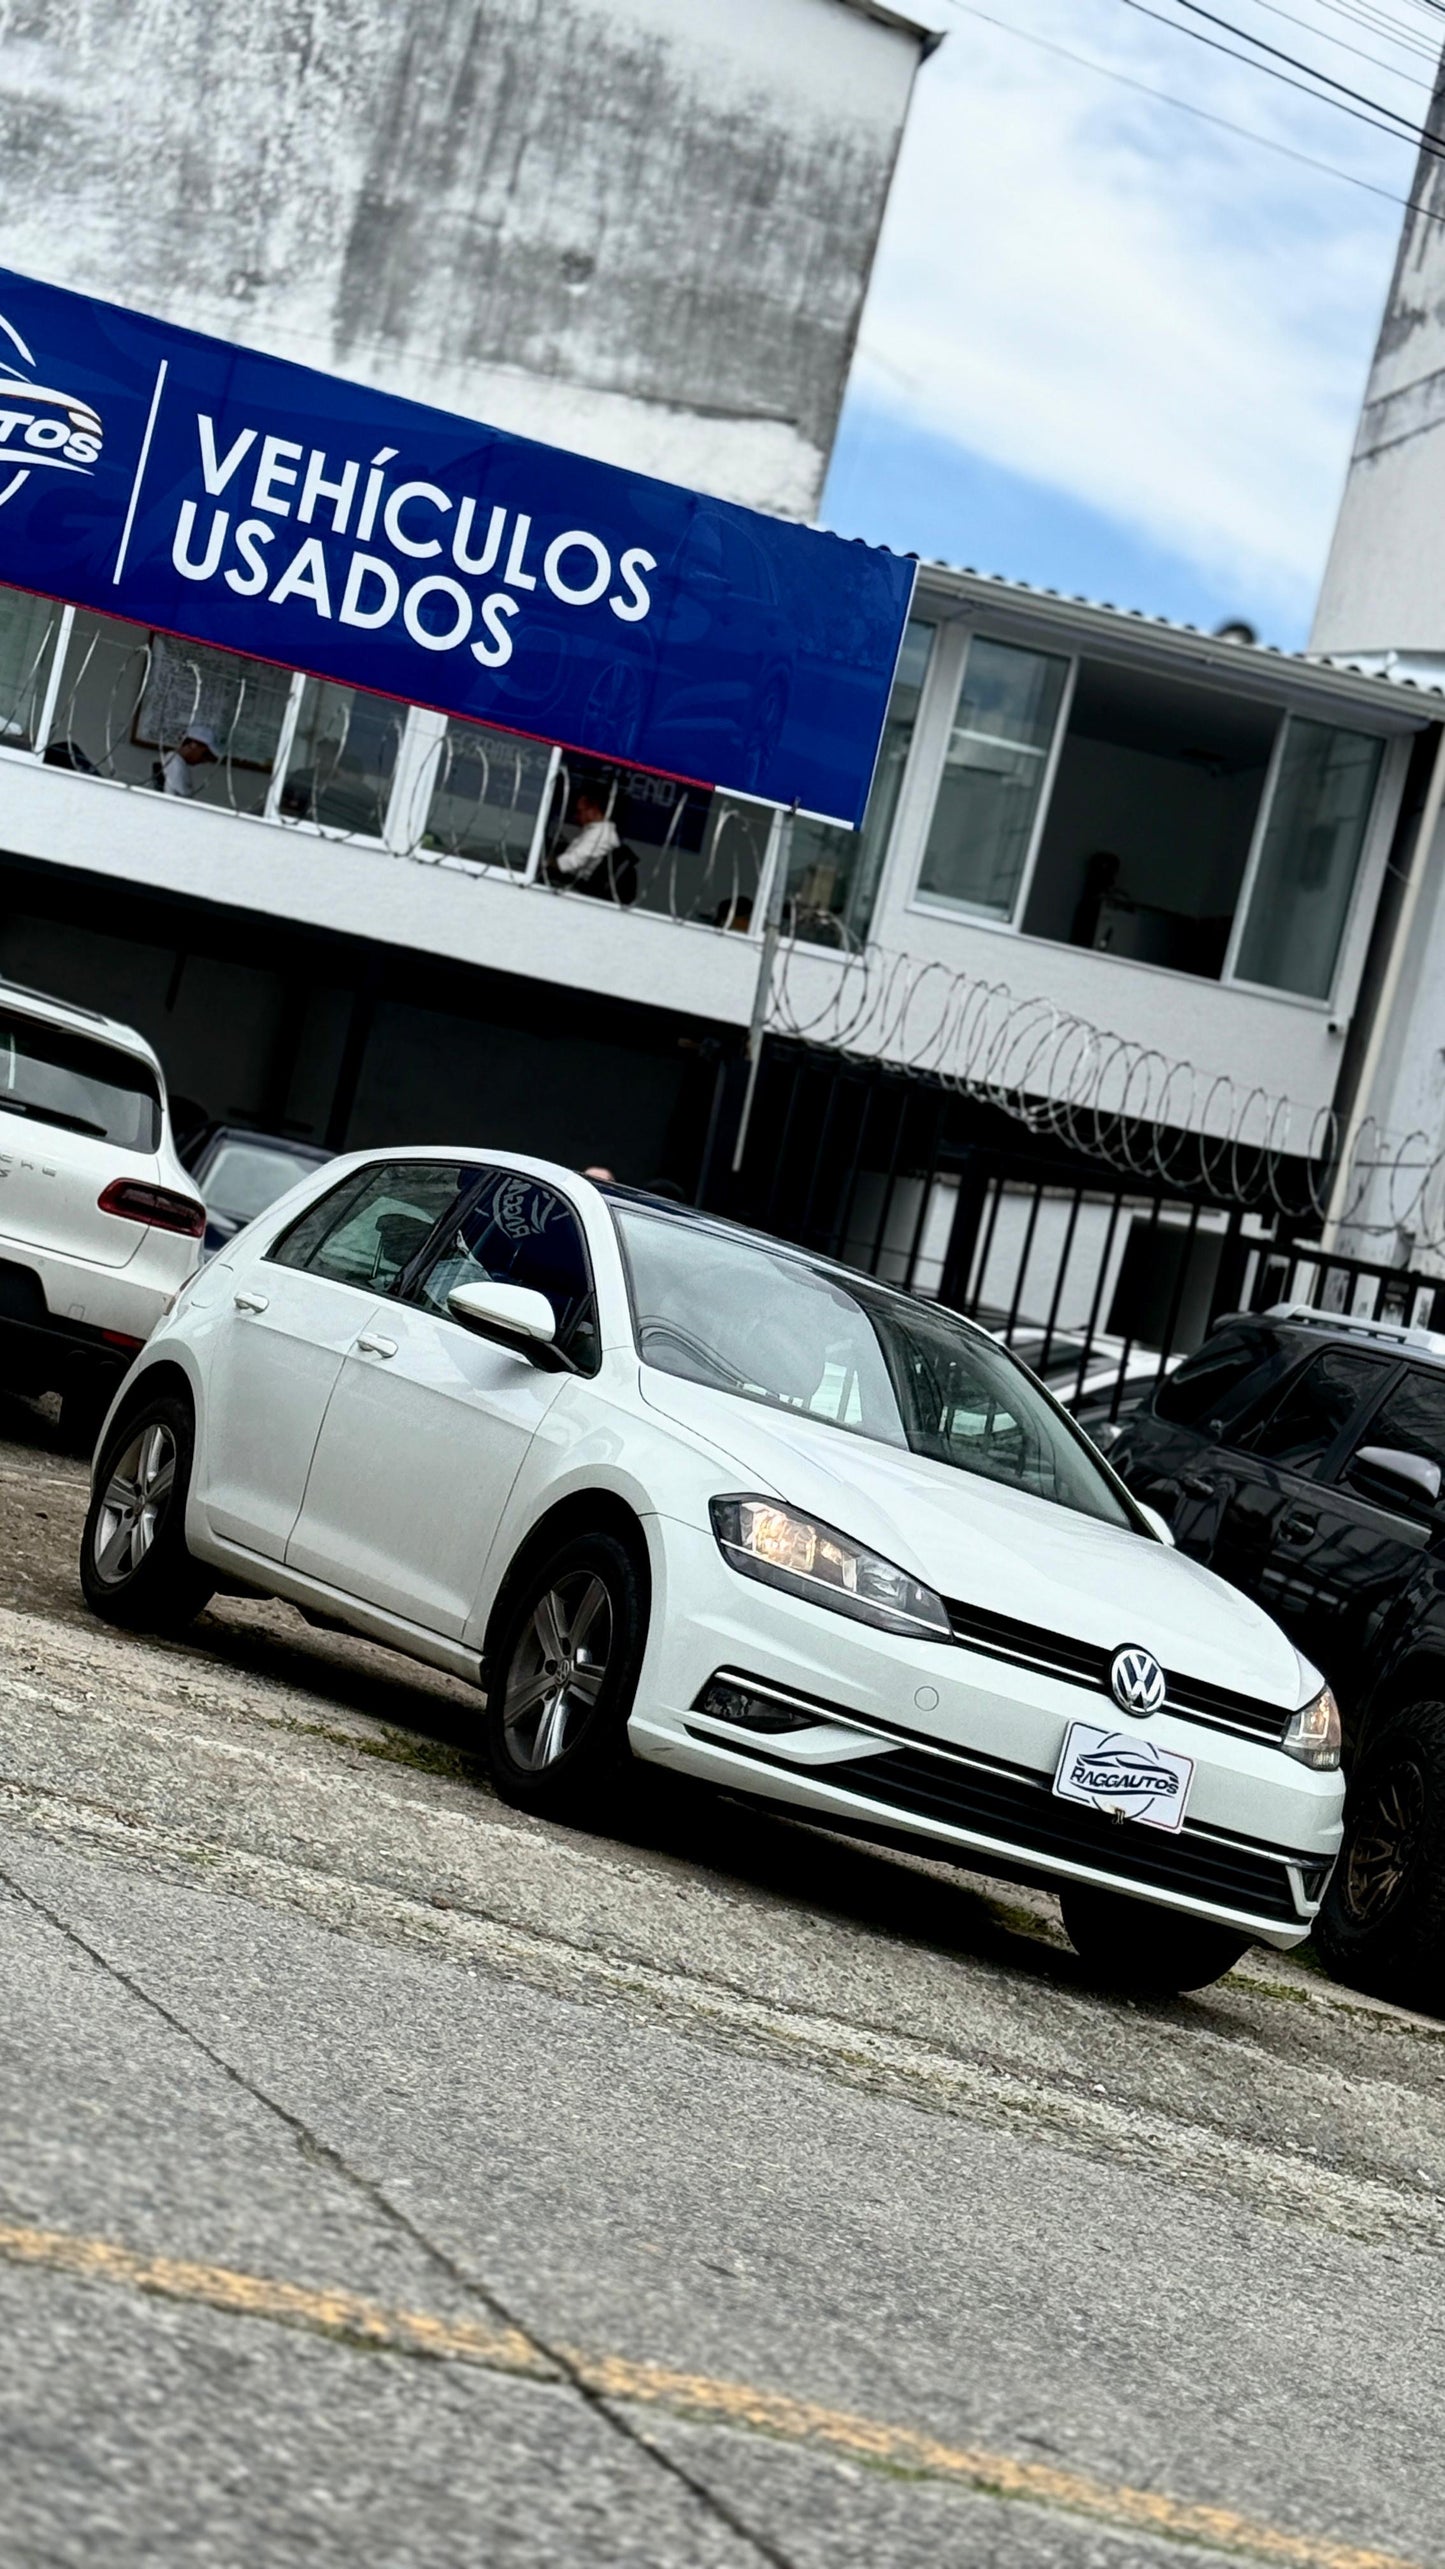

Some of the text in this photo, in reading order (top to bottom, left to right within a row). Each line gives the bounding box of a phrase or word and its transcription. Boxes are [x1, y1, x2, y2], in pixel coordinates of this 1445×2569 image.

[172, 500, 520, 667] USADOS
[197, 413, 657, 622] VEHÍCULOS
[1070, 1765, 1179, 1795] RAGGAUTOS
